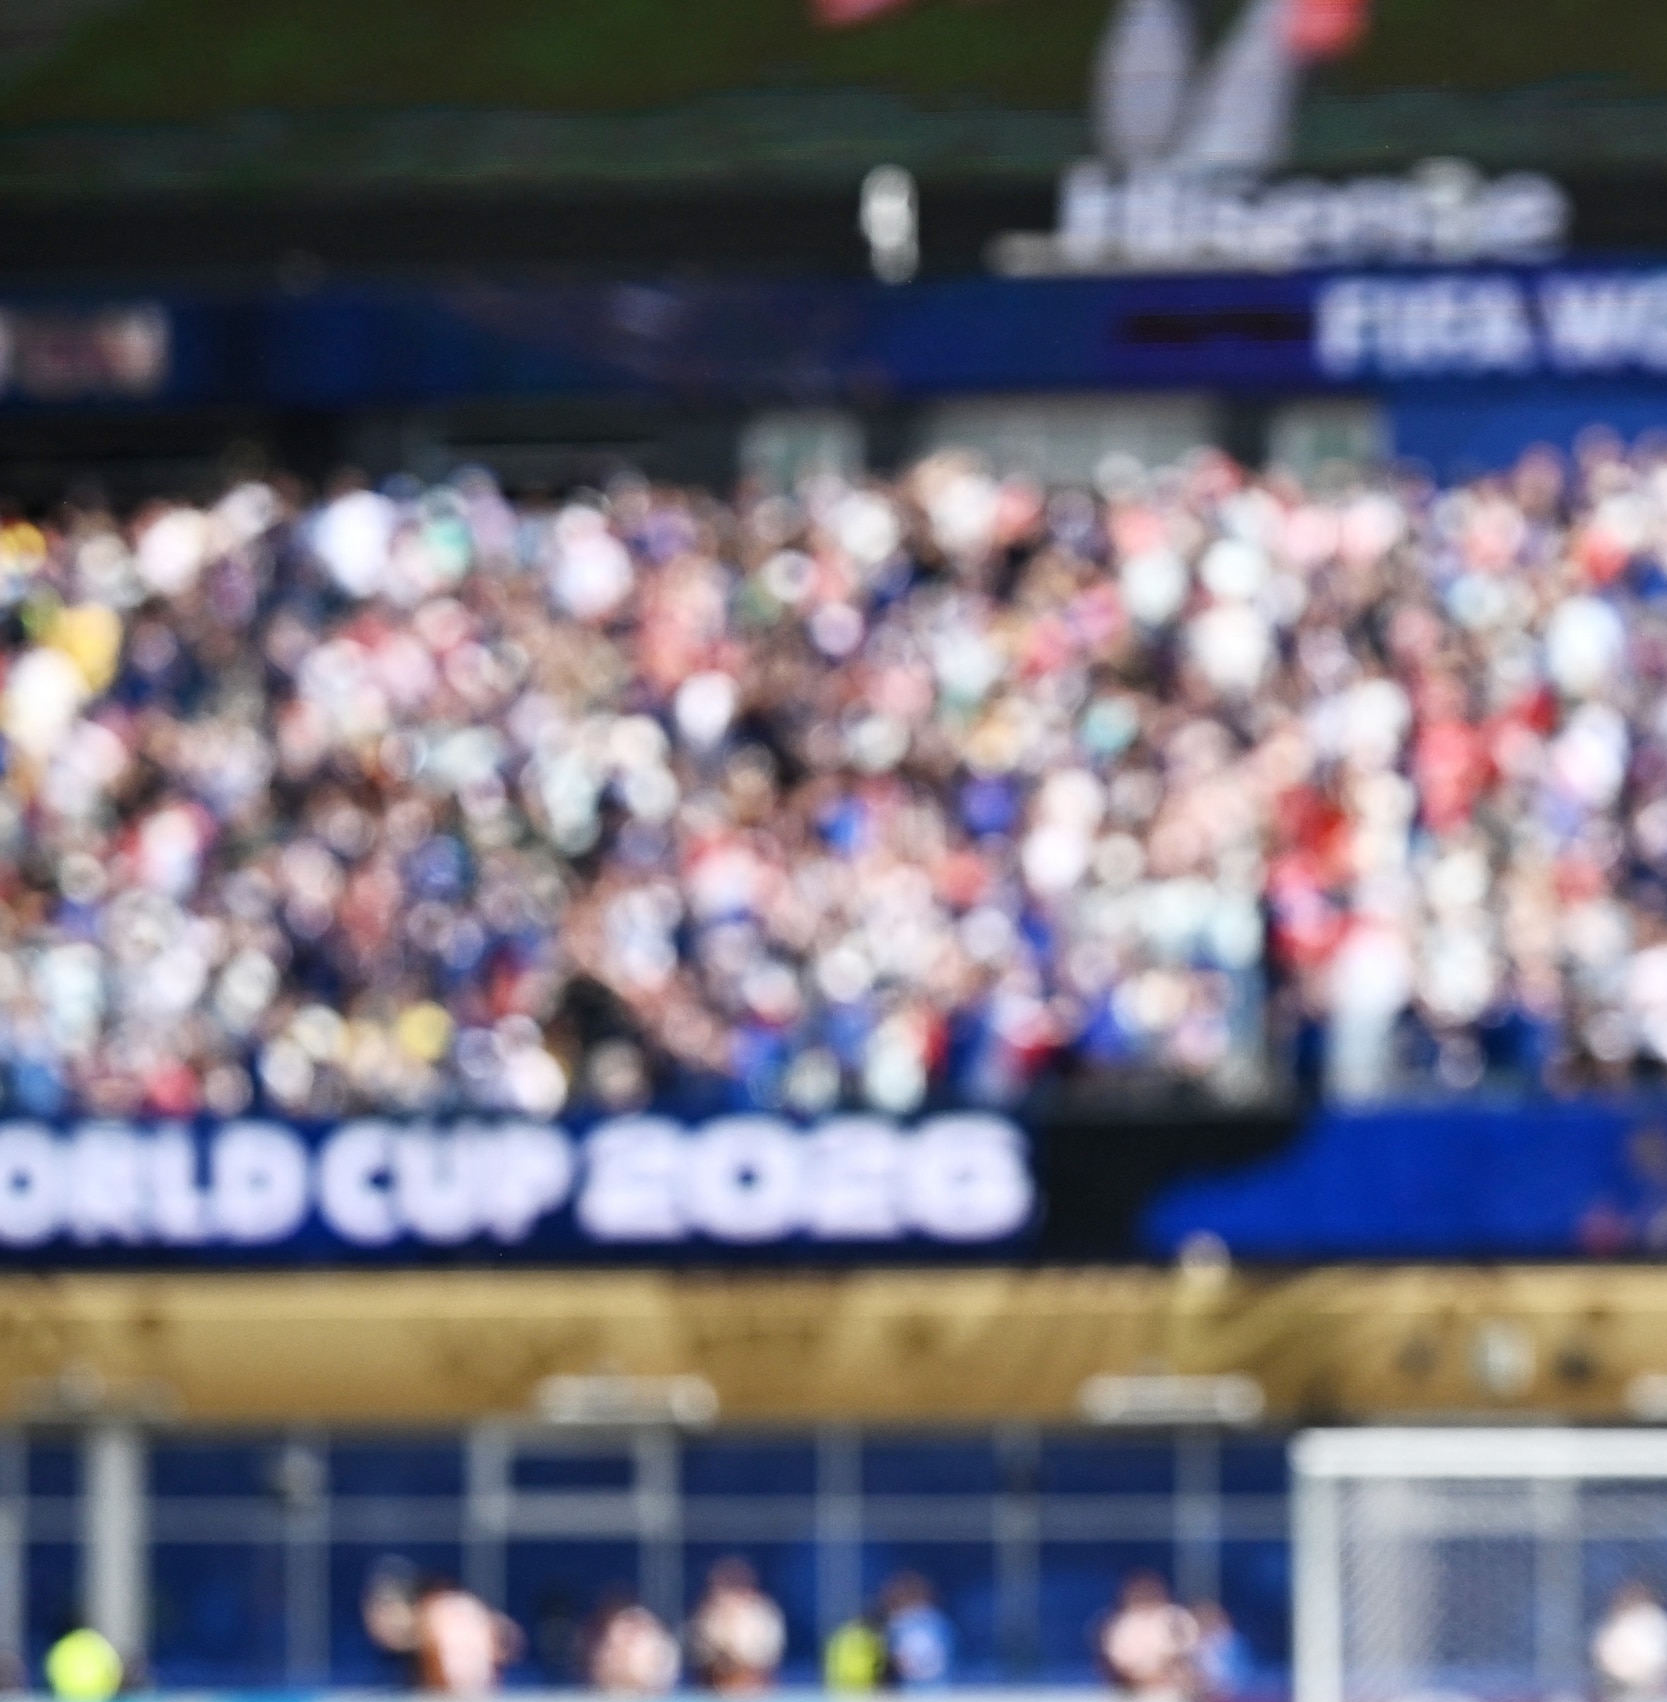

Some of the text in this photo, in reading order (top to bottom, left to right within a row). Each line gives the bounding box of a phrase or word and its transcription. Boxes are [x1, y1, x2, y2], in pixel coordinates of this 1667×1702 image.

[1314, 270, 1529, 376] FIFA
[0, 1113, 1034, 1244] ORLD CUP 2026
